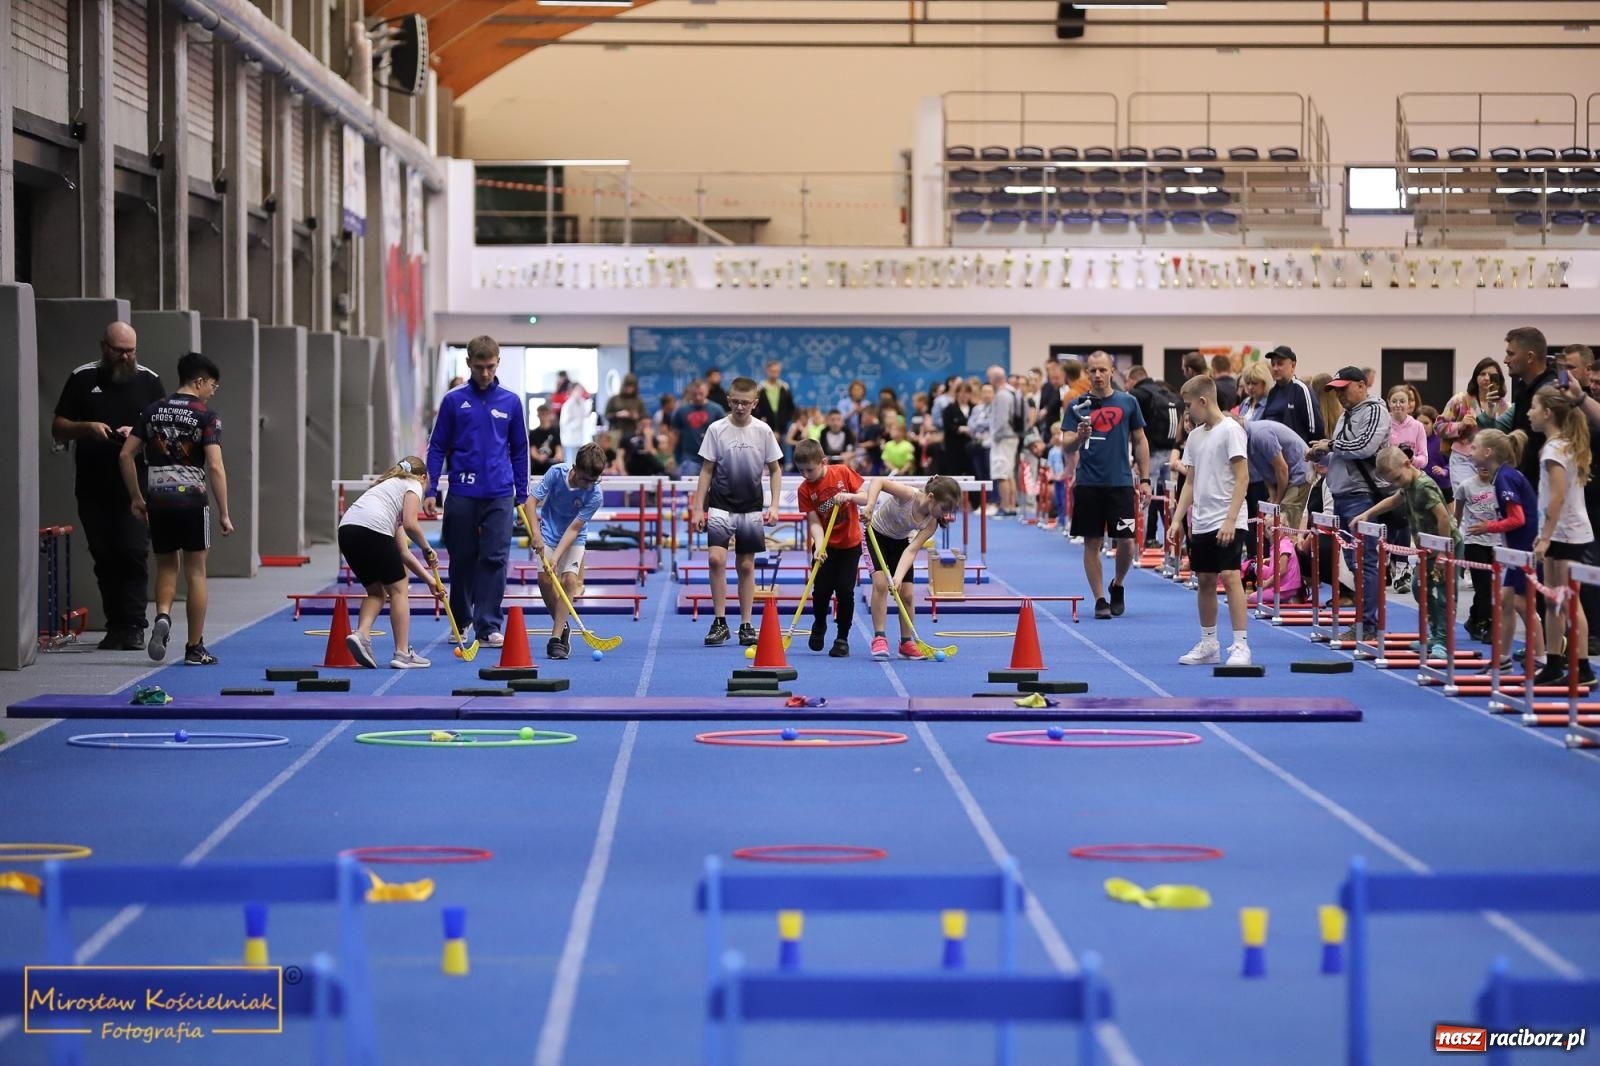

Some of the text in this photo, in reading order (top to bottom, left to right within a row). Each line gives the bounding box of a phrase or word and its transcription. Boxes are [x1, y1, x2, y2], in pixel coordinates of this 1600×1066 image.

[151, 414, 199, 427] CROSS GAMES
[459, 472, 476, 485] 15
